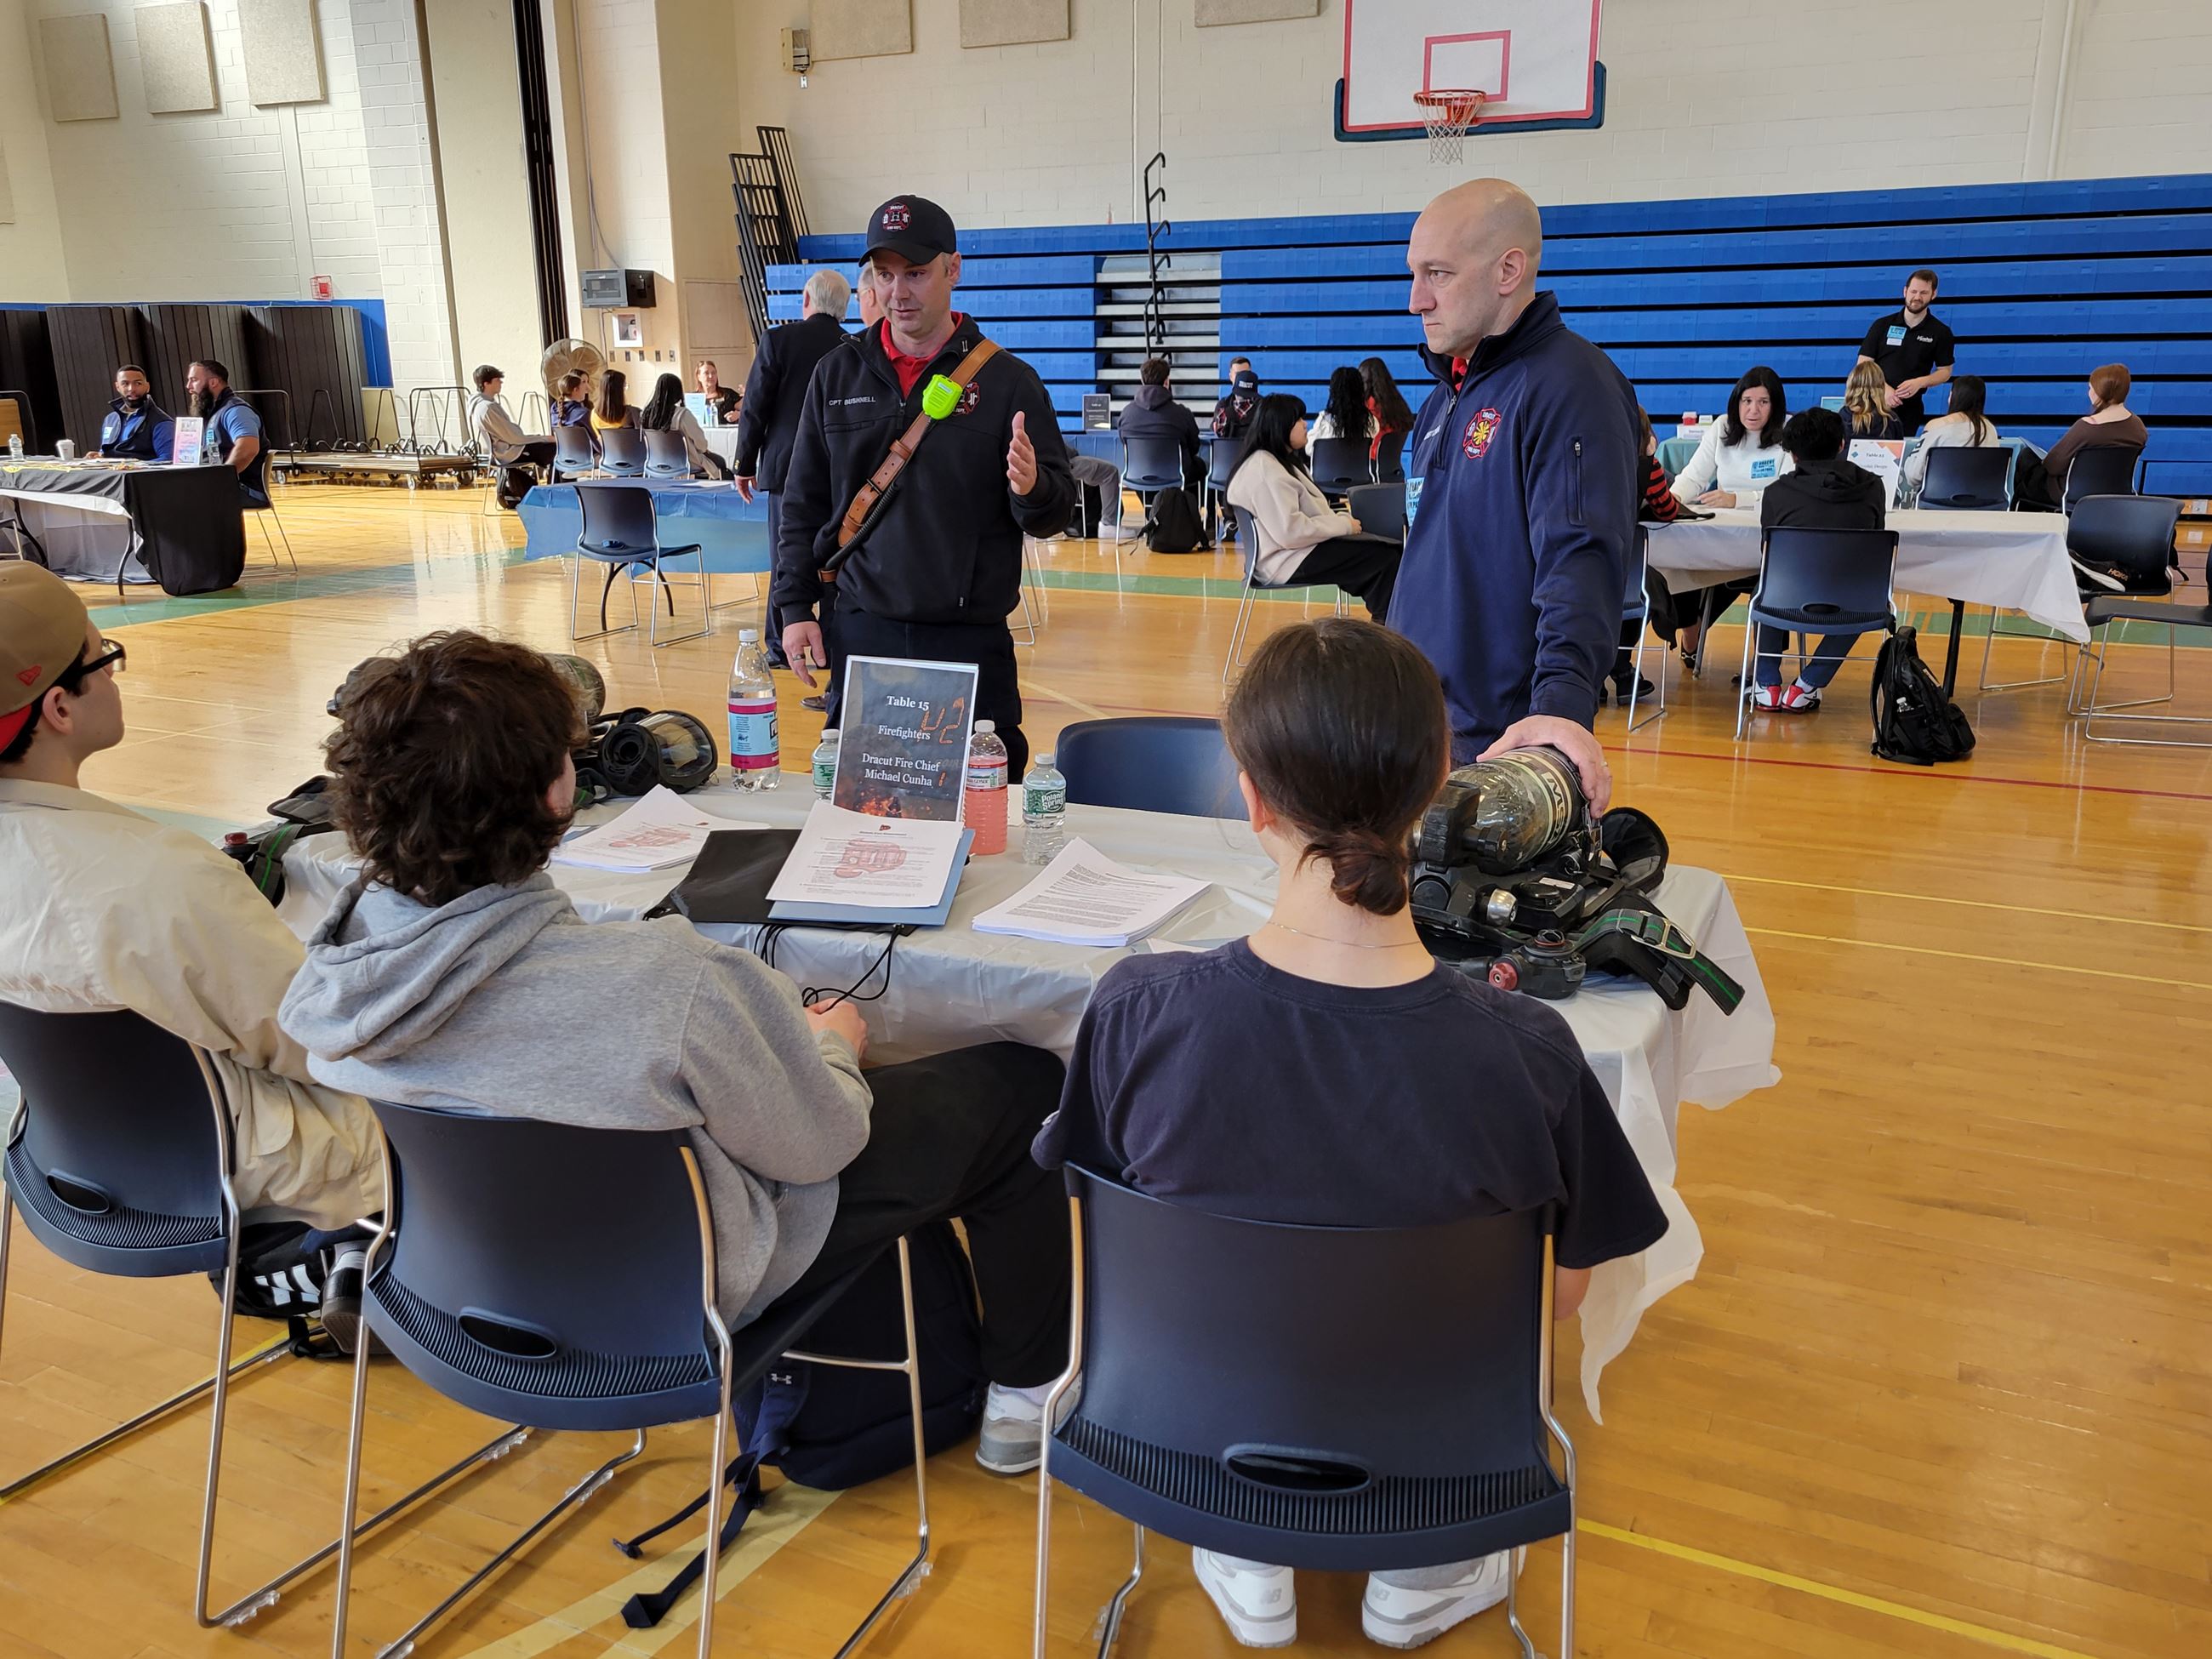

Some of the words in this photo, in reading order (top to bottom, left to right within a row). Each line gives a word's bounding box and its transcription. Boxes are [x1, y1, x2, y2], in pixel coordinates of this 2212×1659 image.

[843, 396, 876, 406] BUSHNELL
[887, 696, 916, 708] Table
[918, 701, 930, 711] 15
[878, 725, 931, 741] Firefighters
[862, 753, 893, 766] Dracut
[895, 757, 914, 768] Fire
[915, 759, 941, 772] Chief
[864, 769, 901, 782] Michael
[902, 773, 932, 786] Cunha
[1041, 791, 1063, 802] Poland
[1042, 798, 1064, 811] Spring
